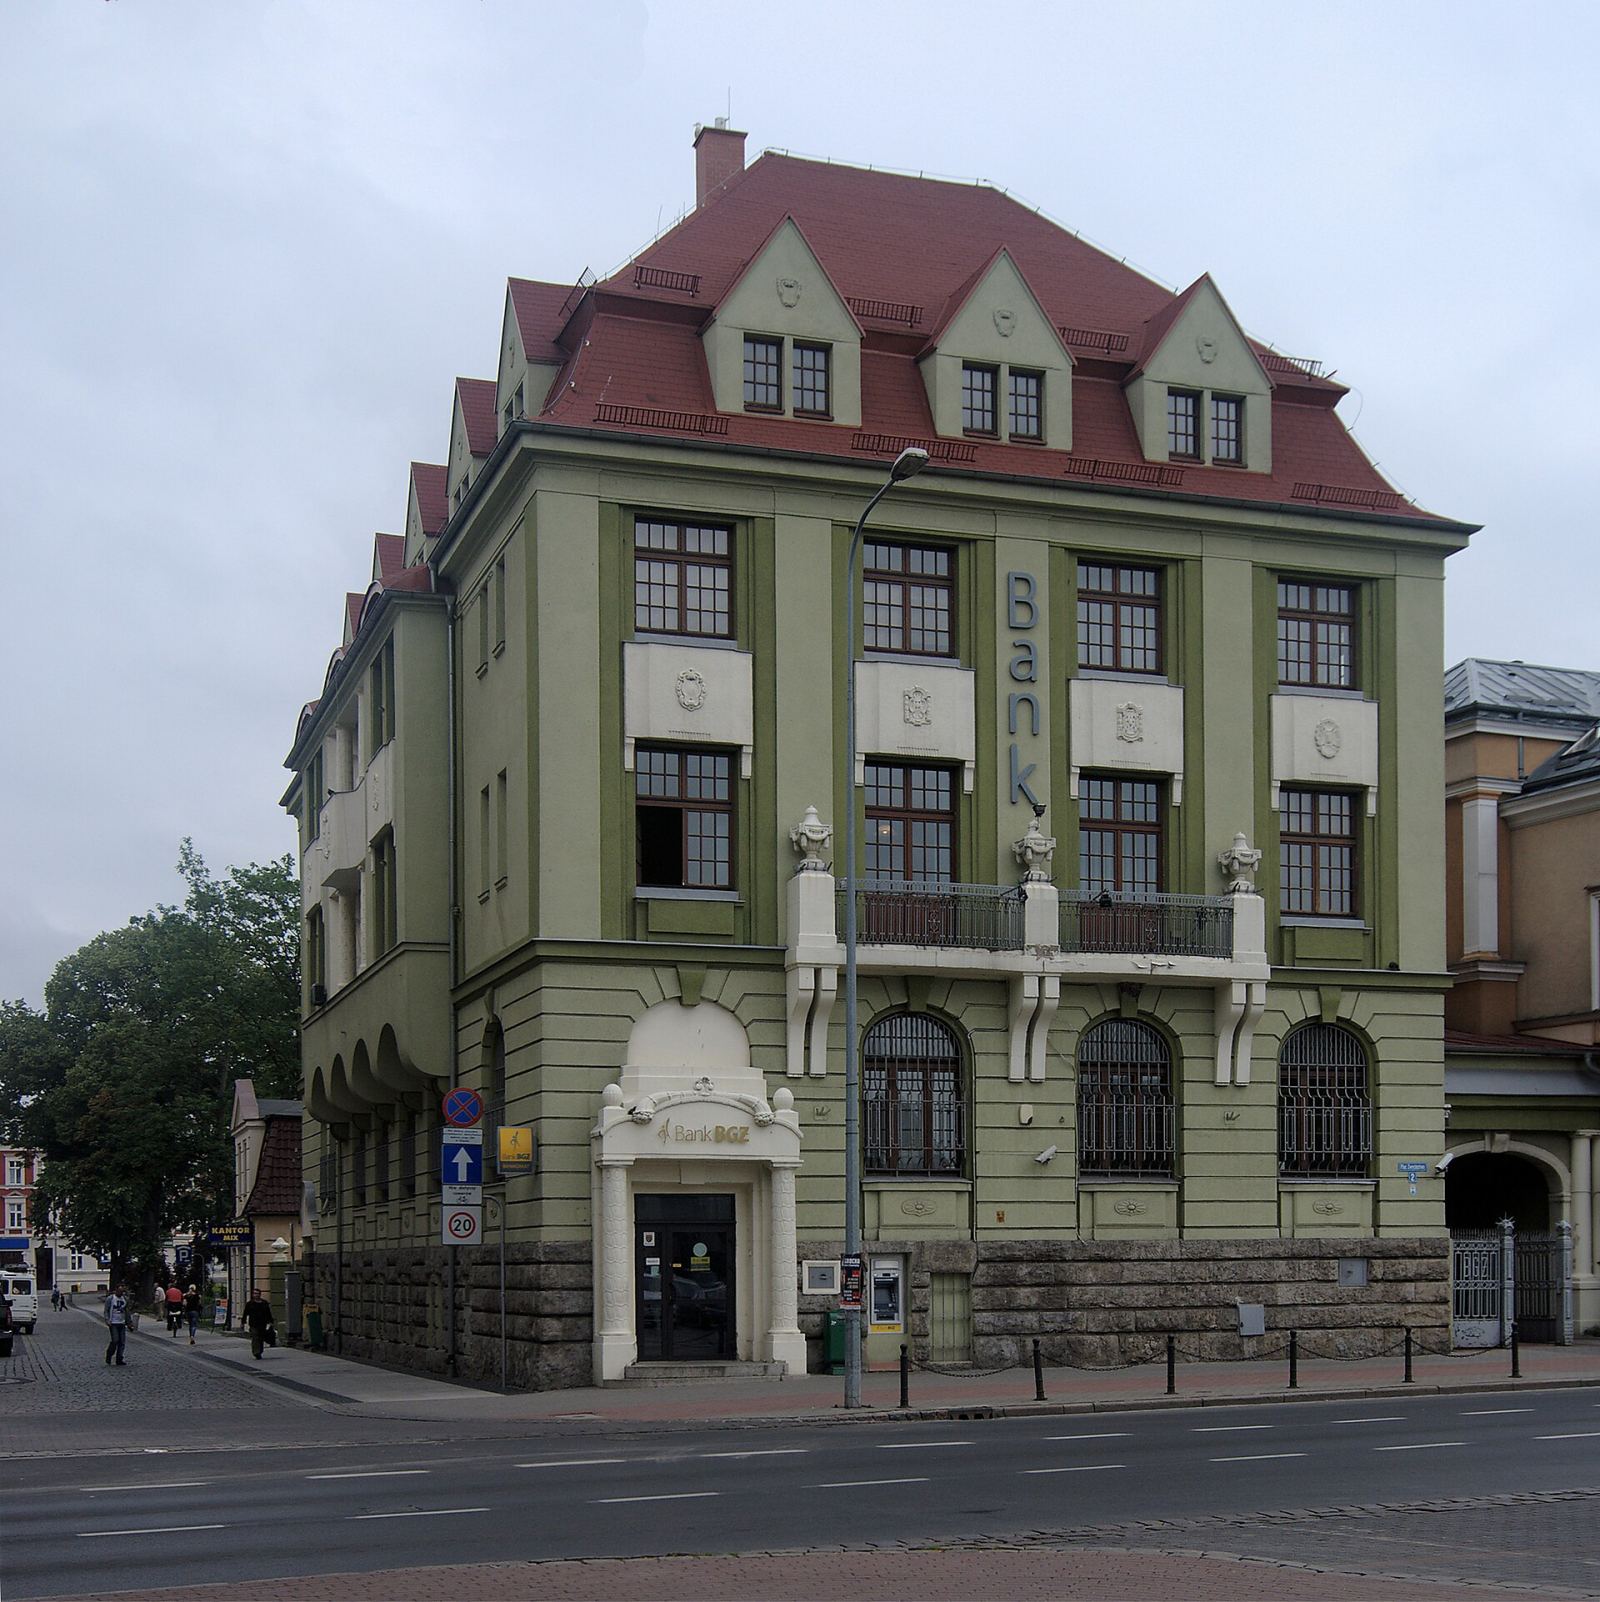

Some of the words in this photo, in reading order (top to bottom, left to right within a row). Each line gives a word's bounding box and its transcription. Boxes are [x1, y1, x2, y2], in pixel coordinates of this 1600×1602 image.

[1008, 571, 1040, 805] Bank
[675, 1125, 712, 1142] Bank
[1410, 1173, 1416, 1182] 2
[453, 1219, 472, 1232] 20
[180, 1250, 188, 1261] P
